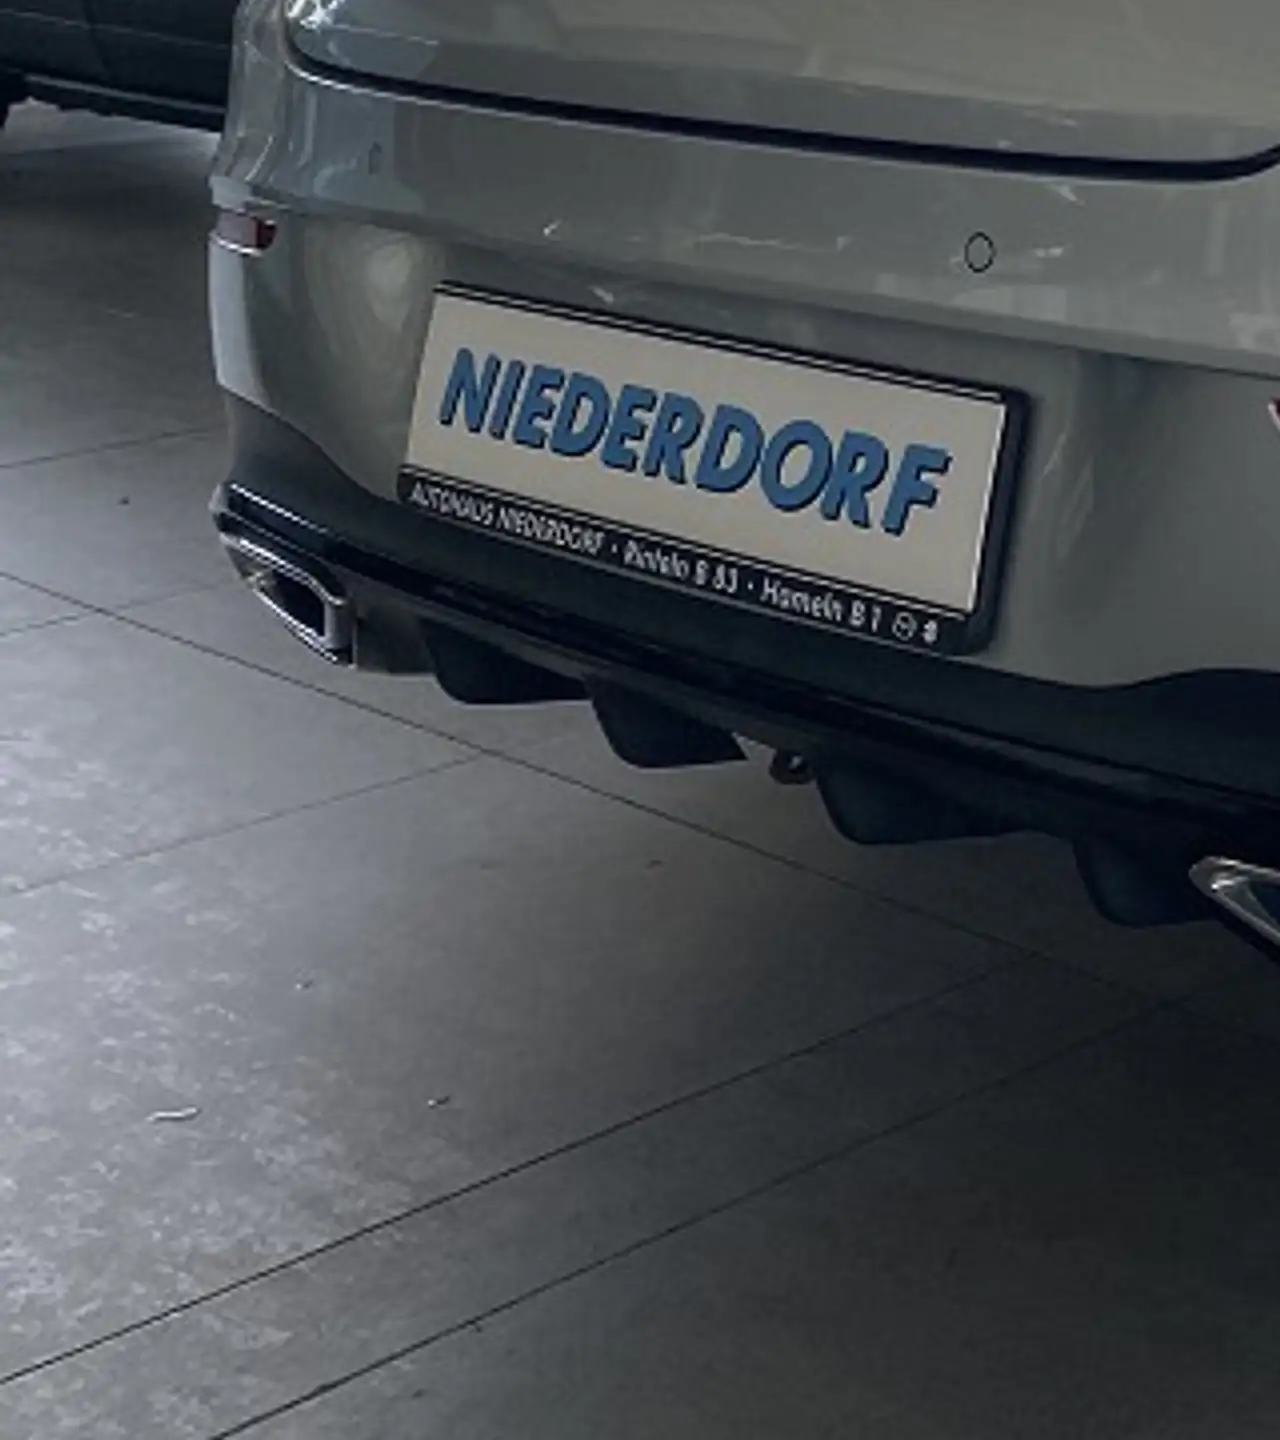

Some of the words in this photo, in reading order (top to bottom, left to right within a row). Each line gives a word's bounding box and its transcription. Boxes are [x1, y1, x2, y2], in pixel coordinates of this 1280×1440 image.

[438, 346, 954, 537] NIEDERDORF
[409, 480, 494, 526] AUTOHAUS
[496, 505, 606, 556] NIEDERDORF
[759, 575, 843, 622] Hameln
[849, 600, 866, 627] B
